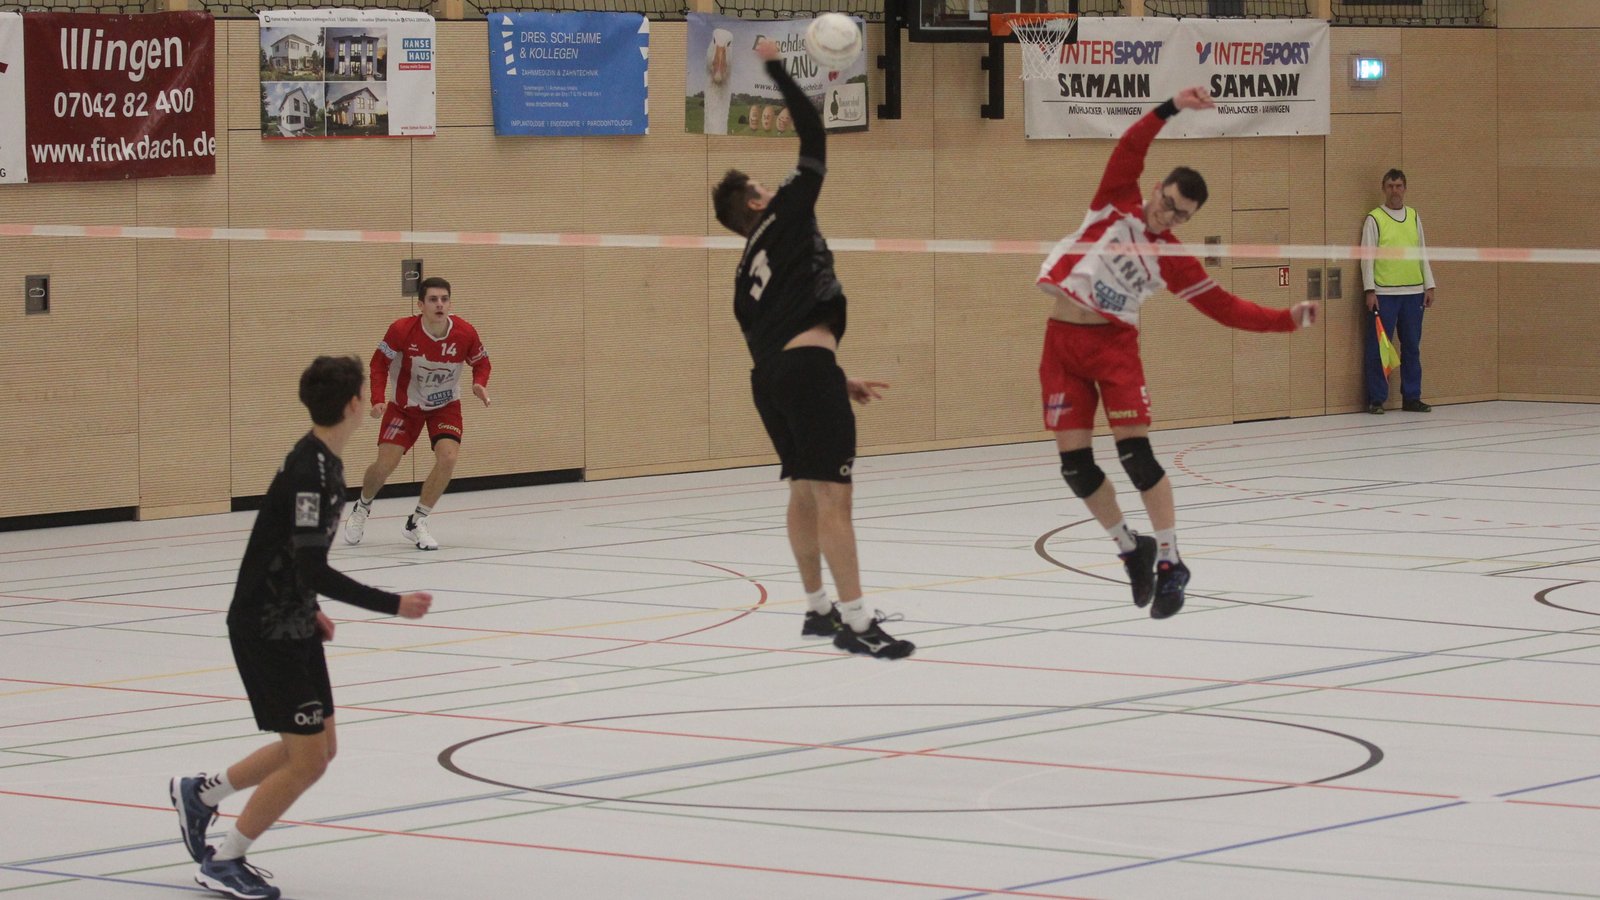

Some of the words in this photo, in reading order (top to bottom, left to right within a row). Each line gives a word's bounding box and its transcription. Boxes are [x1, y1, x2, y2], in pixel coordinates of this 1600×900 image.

[403, 39, 429, 48] HANSE
[520, 31, 549, 43] DRES.
[550, 32, 602, 44] SCHLEMME
[60, 27, 184, 84] Illingen
[408, 51, 430, 61] HAUS
[519, 47, 527, 59] &
[528, 47, 579, 60] KOLLEGEN
[1059, 40, 1163, 65] INTERSPORT
[1214, 41, 1311, 66] INTERSPORT
[521, 69, 555, 77] ZAHNMEDIZIN
[562, 69, 599, 77] ZAHNTECHNIK
[1057, 72, 1151, 98] SÄMANN
[1210, 73, 1300, 98] SÄMANN
[53, 91, 116, 119] 07042
[122, 91, 148, 118] 82
[155, 87, 194, 115] 400
[1068, 103, 1102, 116] MÜHLACKER
[1106, 106, 1142, 116] VAIHINGEN
[1217, 104, 1259, 115] MÜHLACKER
[1262, 105, 1291, 114] VAIHINGEN
[587, 119, 633, 127] PARODONTOLOGIE
[31, 131, 216, 165] www.finkdach.de
[440, 342, 457, 357] 14
